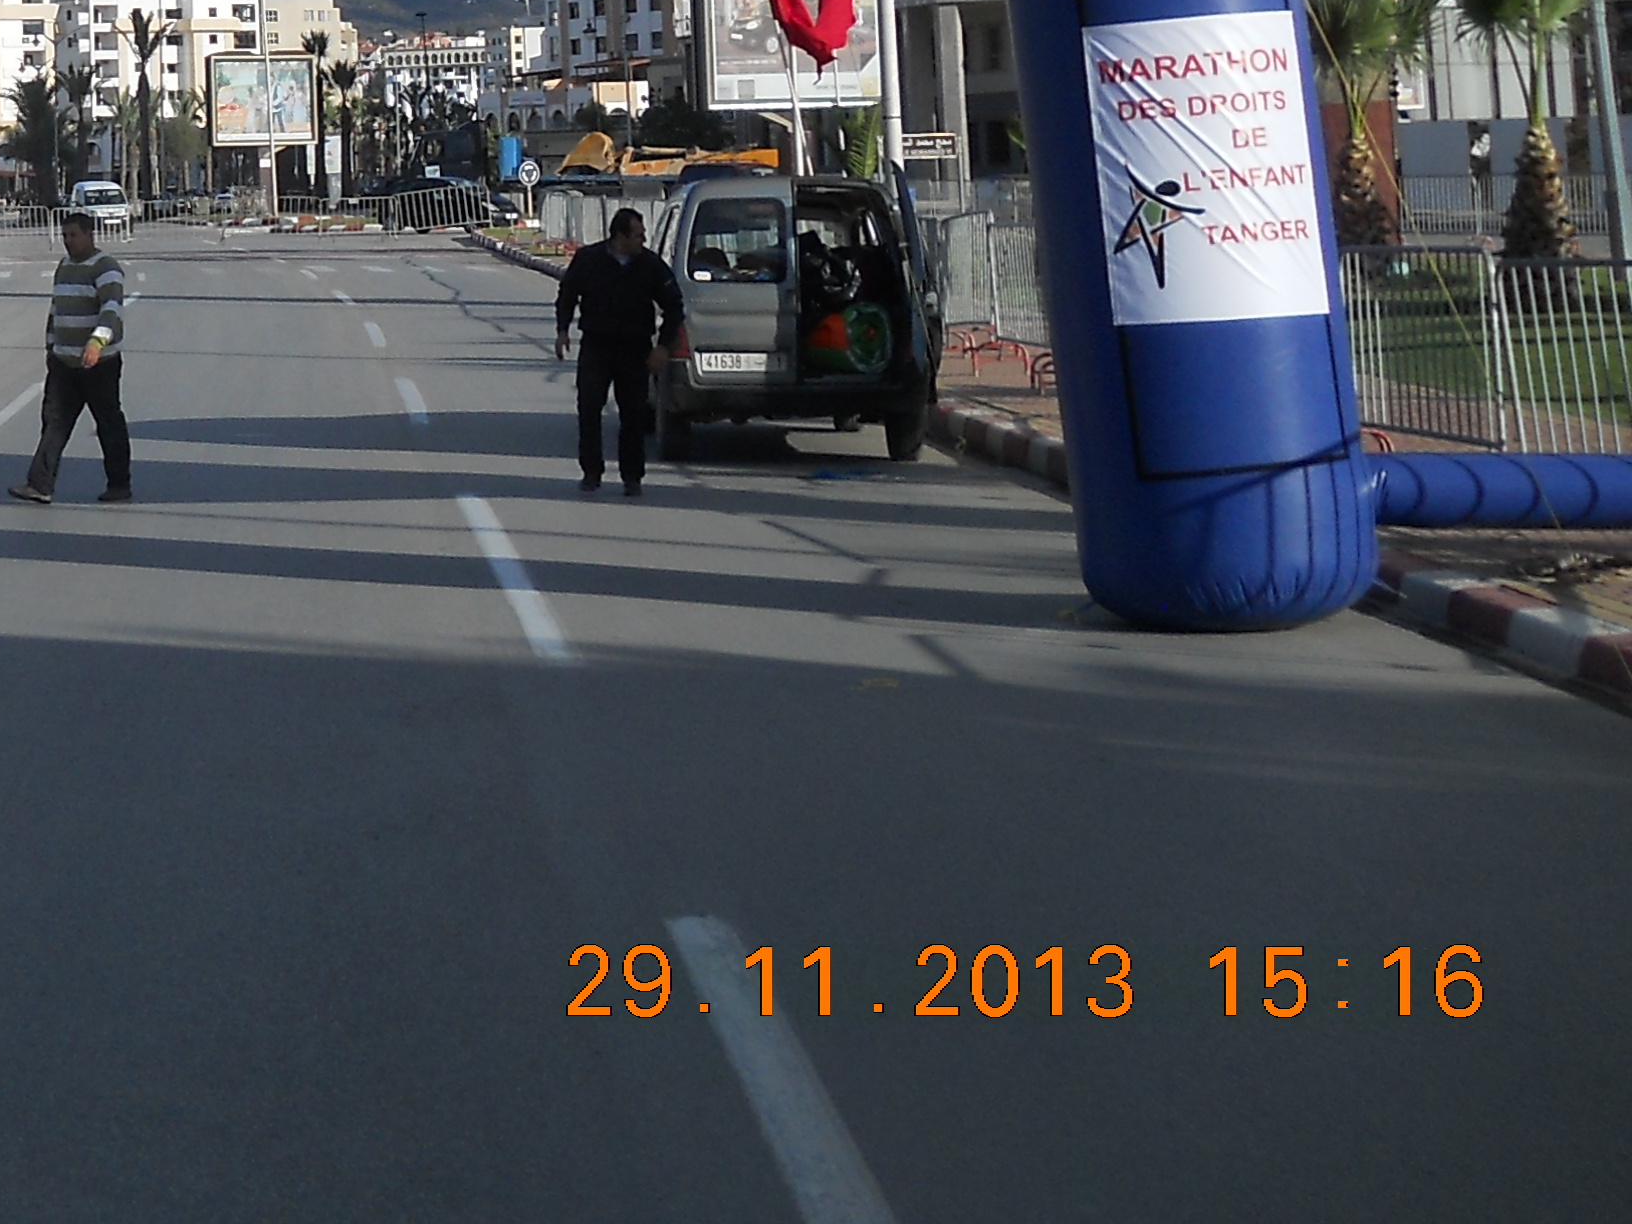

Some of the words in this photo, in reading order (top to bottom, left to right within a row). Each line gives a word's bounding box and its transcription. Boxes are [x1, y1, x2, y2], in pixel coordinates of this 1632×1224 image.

[1098, 48, 1289, 84] MARATHON
[1118, 97, 1177, 122] DES
[1187, 90, 1286, 117] DROITS
[1231, 127, 1268, 149] DE
[1183, 164, 1306, 192] L'ENFANT
[1204, 219, 1309, 245] TANGER
